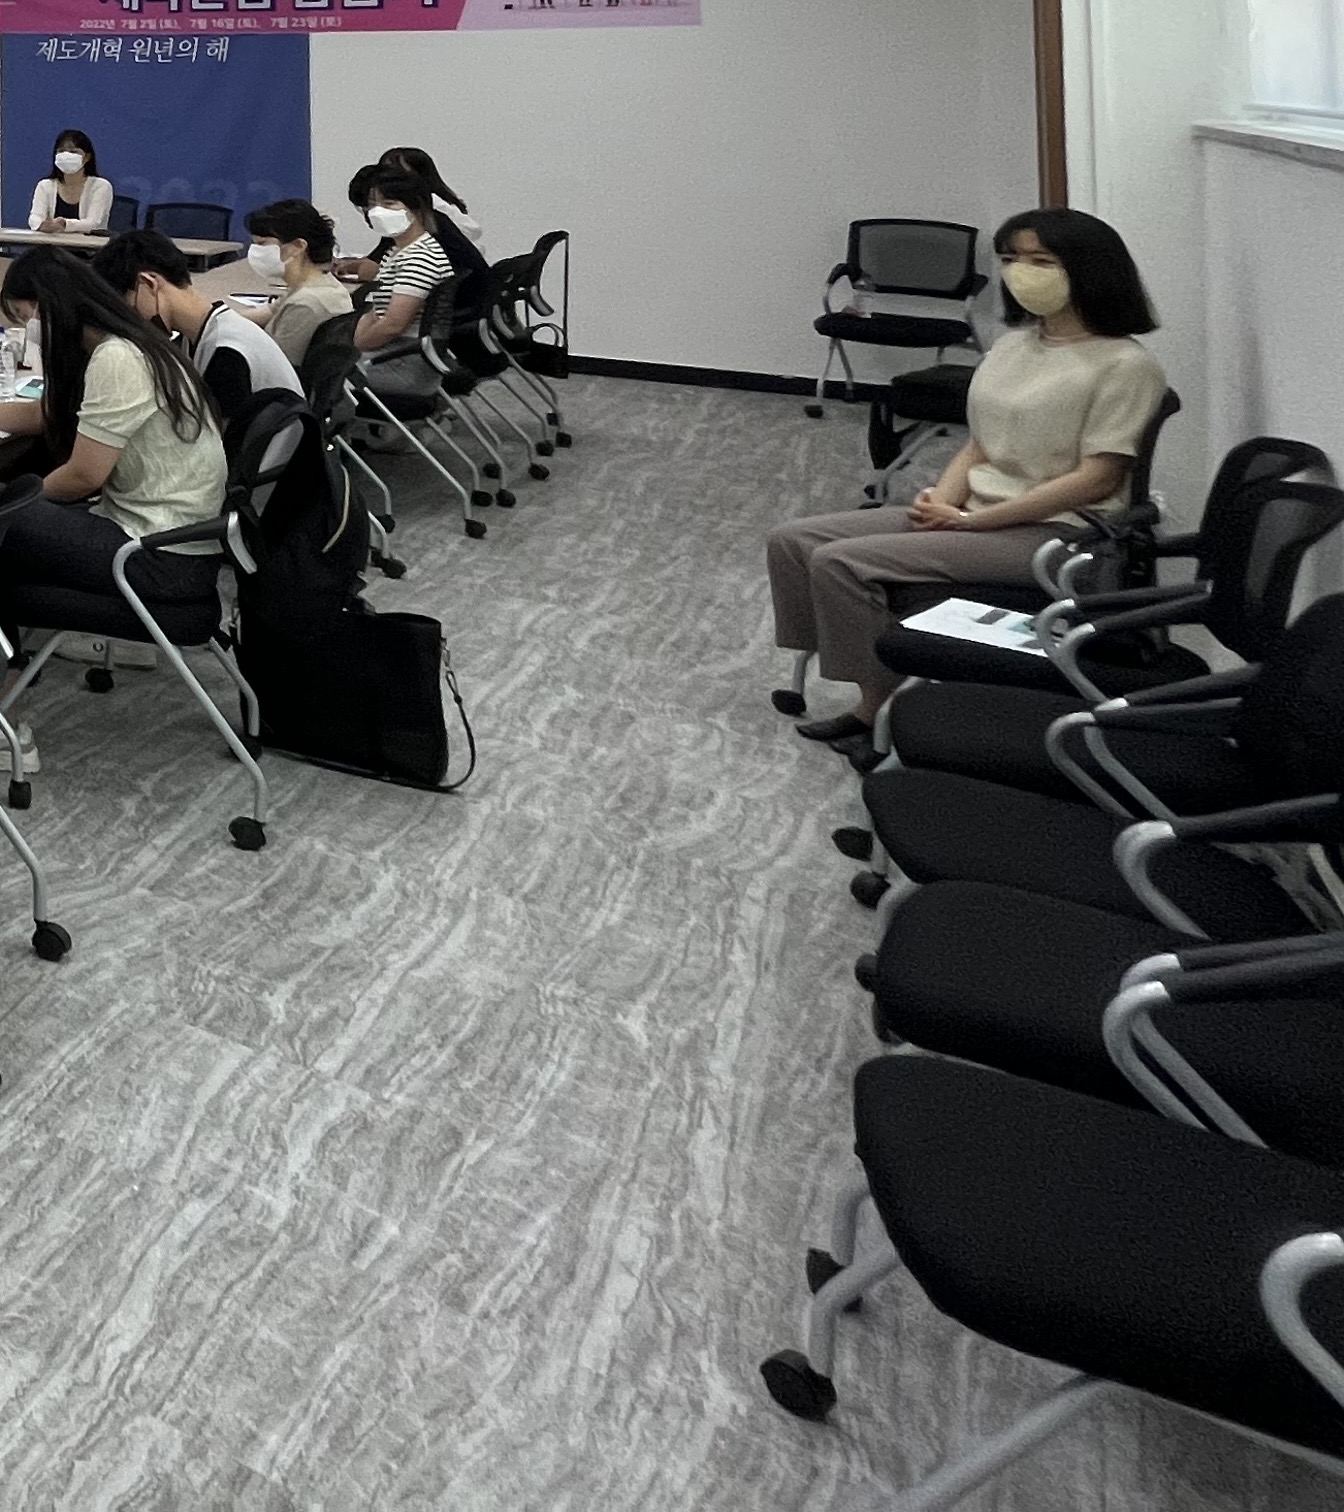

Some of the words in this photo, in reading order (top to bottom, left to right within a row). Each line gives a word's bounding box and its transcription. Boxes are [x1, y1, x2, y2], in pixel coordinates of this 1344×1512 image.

[36, 38, 123, 62] 제도개혁
[128, 37, 199, 64] 원년의
[206, 36, 230, 63] 해
